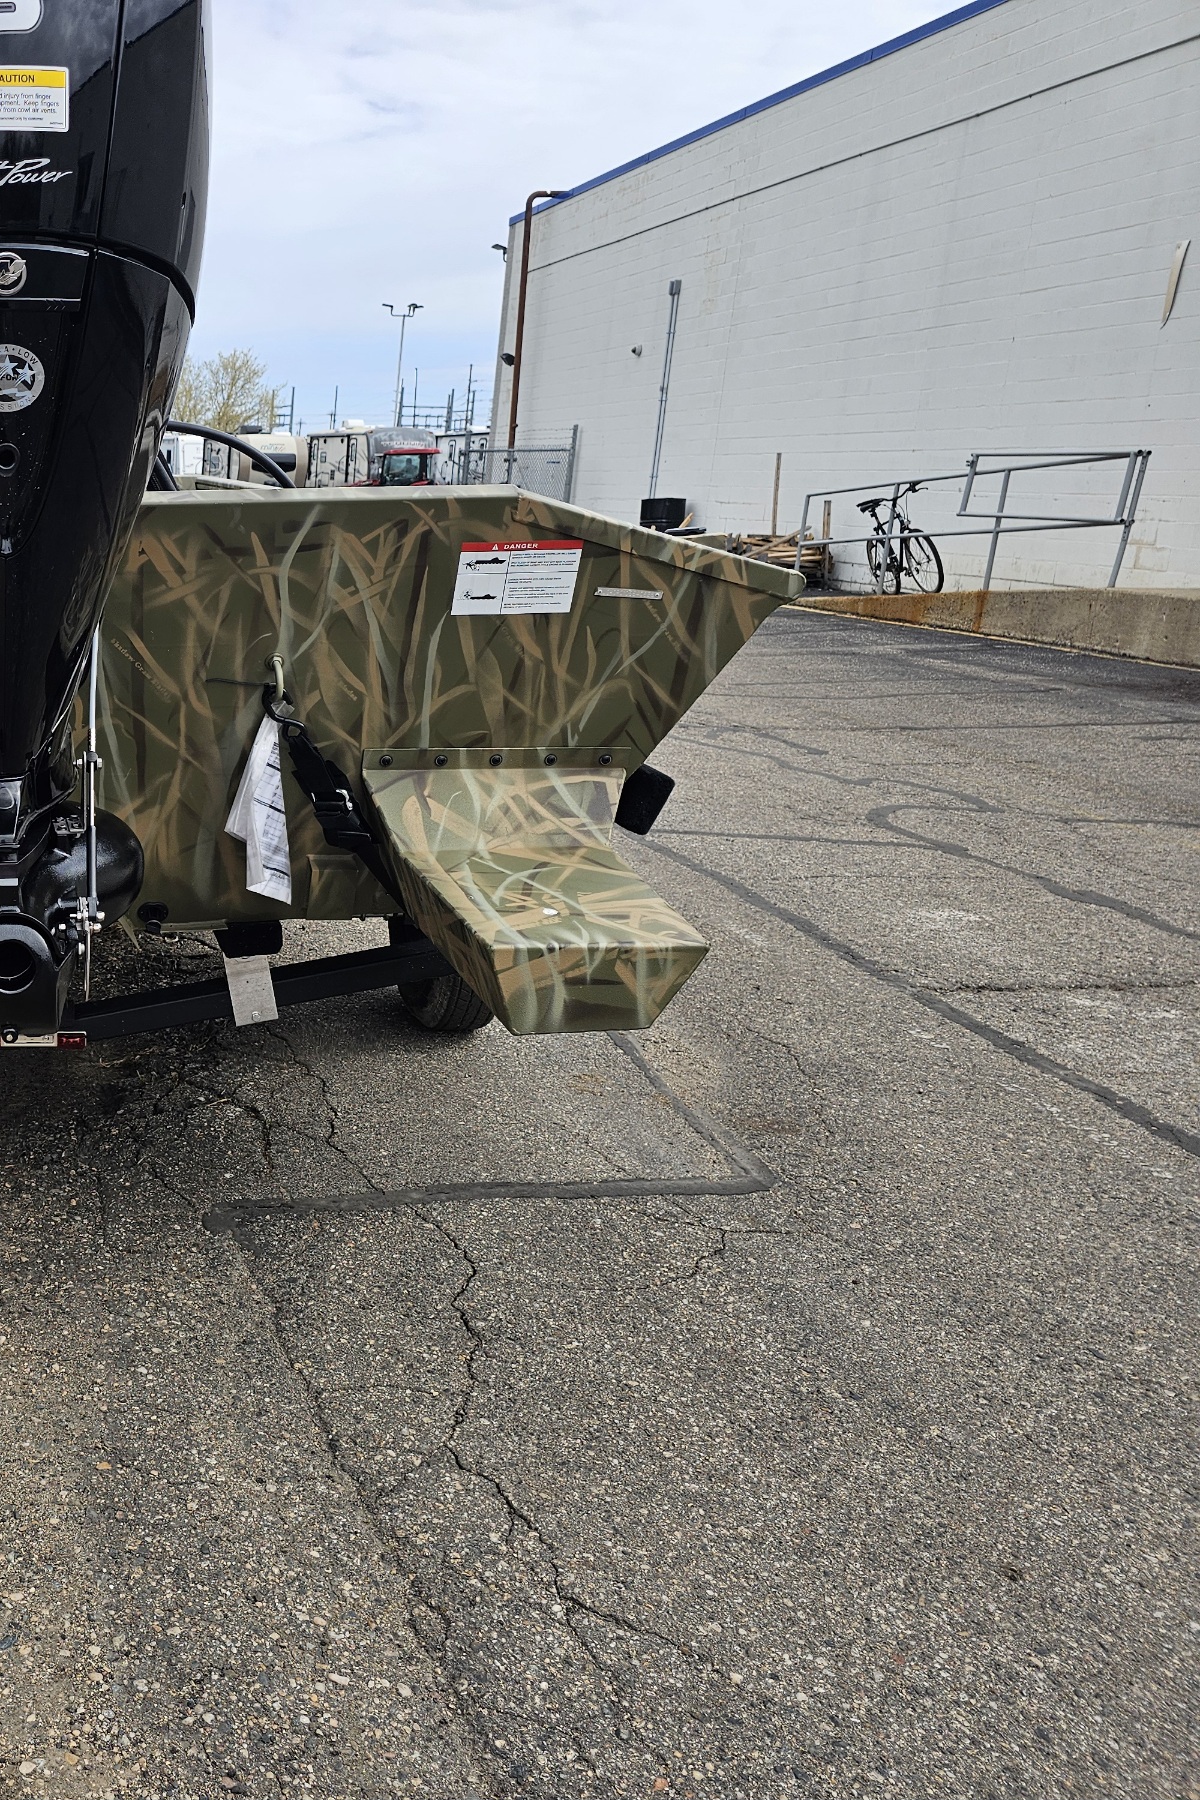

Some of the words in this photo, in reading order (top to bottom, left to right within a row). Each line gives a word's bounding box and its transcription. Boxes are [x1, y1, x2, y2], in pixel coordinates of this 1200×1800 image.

[35, 93, 51, 101] finger
[40, 100, 60, 108] fingers
[17, 348, 39, 365] LOW
